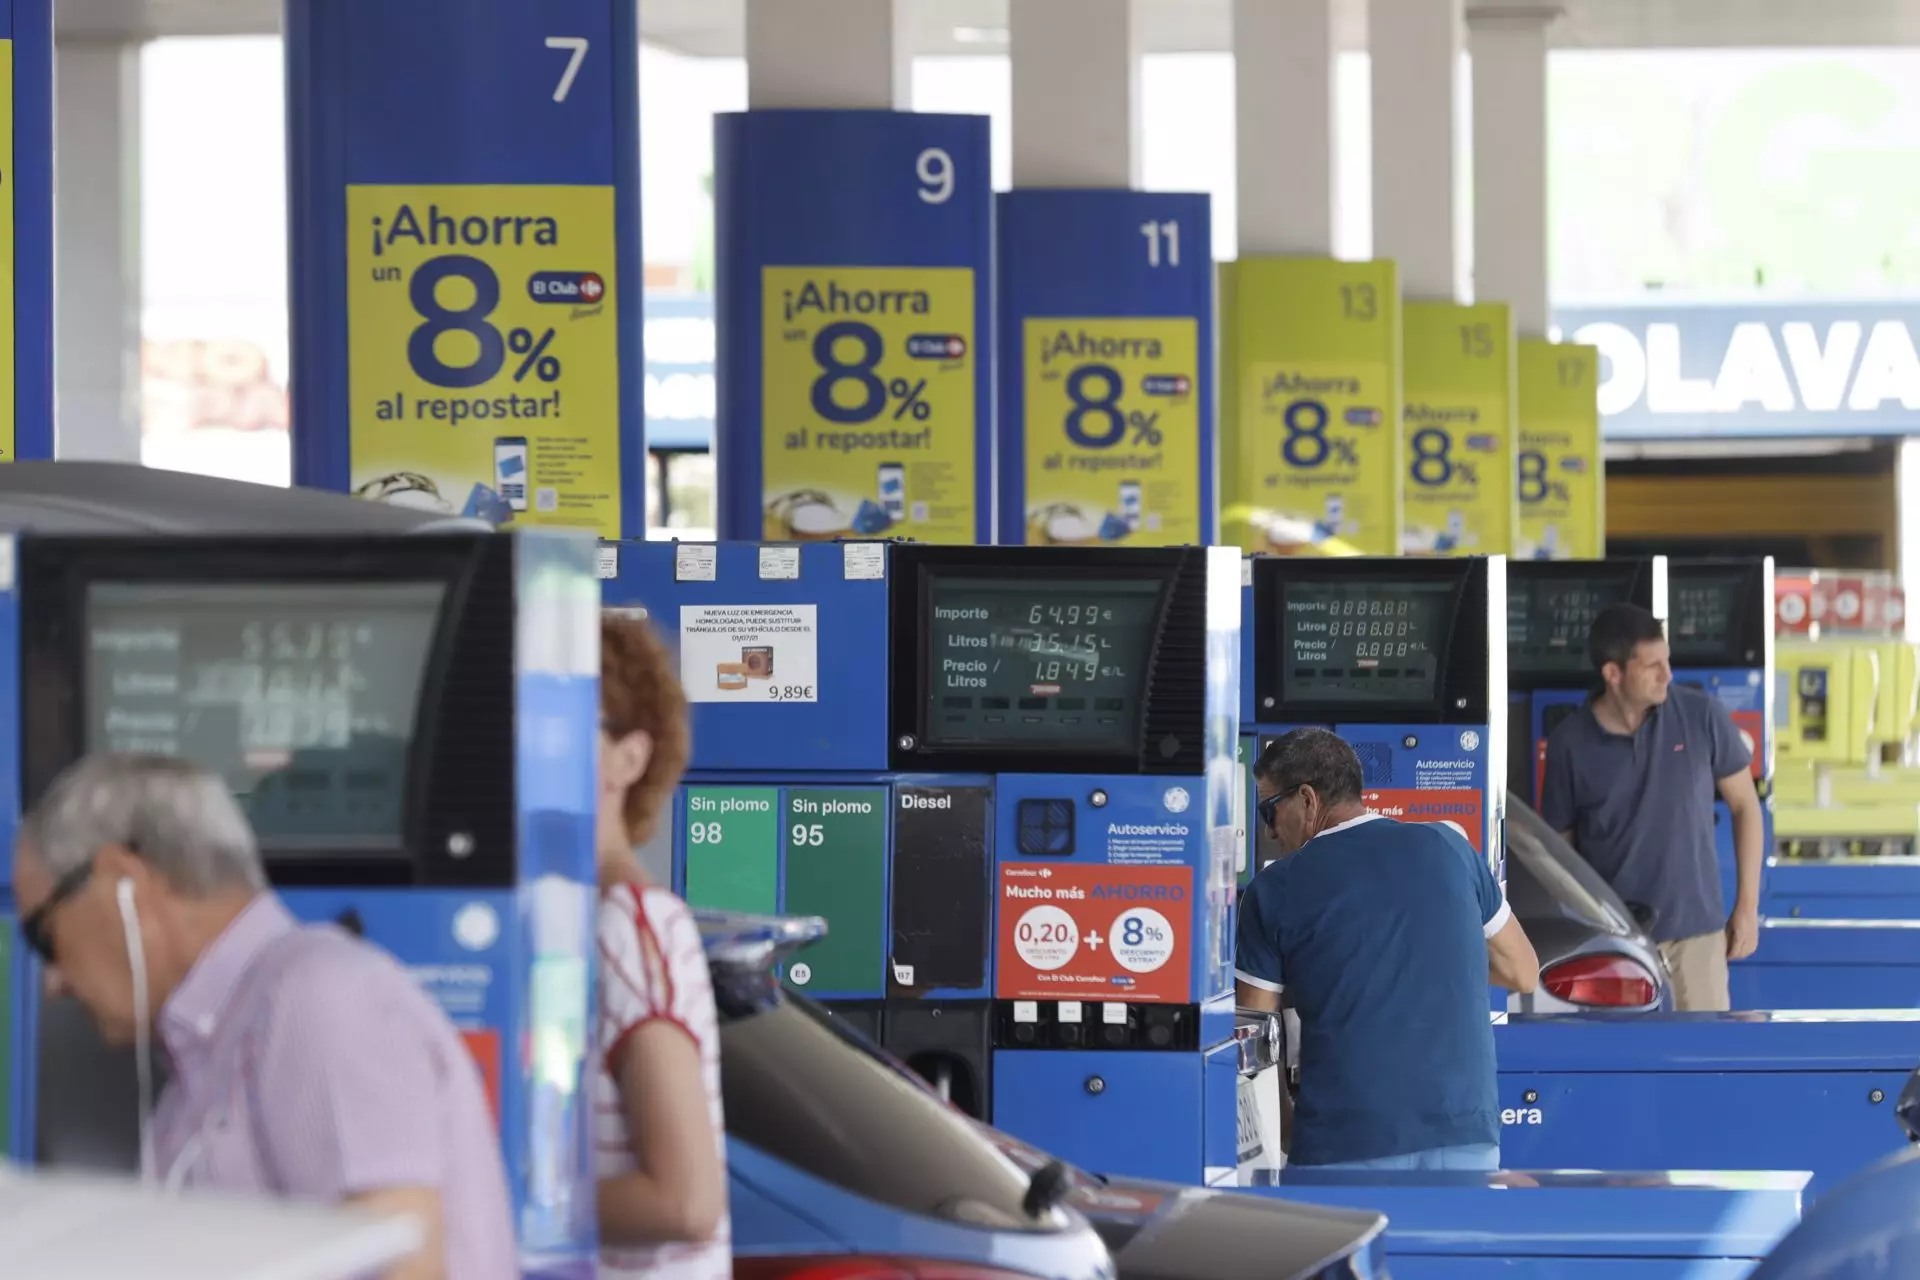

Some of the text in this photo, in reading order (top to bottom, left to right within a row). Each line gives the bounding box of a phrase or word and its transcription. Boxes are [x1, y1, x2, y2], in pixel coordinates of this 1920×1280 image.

[544, 36, 589, 103] 7
[916, 147, 954, 203] 9
[371, 204, 558, 257] ¡Ahorra
[1139, 219, 1179, 267] 11
[783, 280, 930, 322] ¡Ahorra
[1340, 283, 1378, 321] 13
[372, 266, 401, 282] un
[407, 254, 561, 389] 8%
[1459, 323, 1494, 357] 15
[811, 320, 931, 425] 8%
[376, 389, 561, 425] al repostar!
[1064, 361, 1163, 449] 8%
[785, 427, 932, 454] al repostar!
[935, 606, 989, 621] Importe
[1297, 621, 1327, 632] Litros
[948, 634, 988, 648] Litros
[1294, 639, 1327, 649] Precio
[1297, 651, 1327, 661] Litros
[943, 659, 988, 672] Precio
[947, 675, 988, 688] Litros
[768, 685, 813, 701] 9,89€
[1416, 759, 1475, 769] Autoservicio
[690, 797, 770, 814] Sin plomo
[792, 799, 872, 816] Sin plomo
[901, 794, 951, 810] Diesel
[690, 822, 723, 844] 98
[792, 823, 824, 846] 95
[1107, 822, 1190, 836] Autoservicio
[1005, 883, 1186, 901] Mucho más AHORRO
[1501, 1108, 1542, 1125] era
